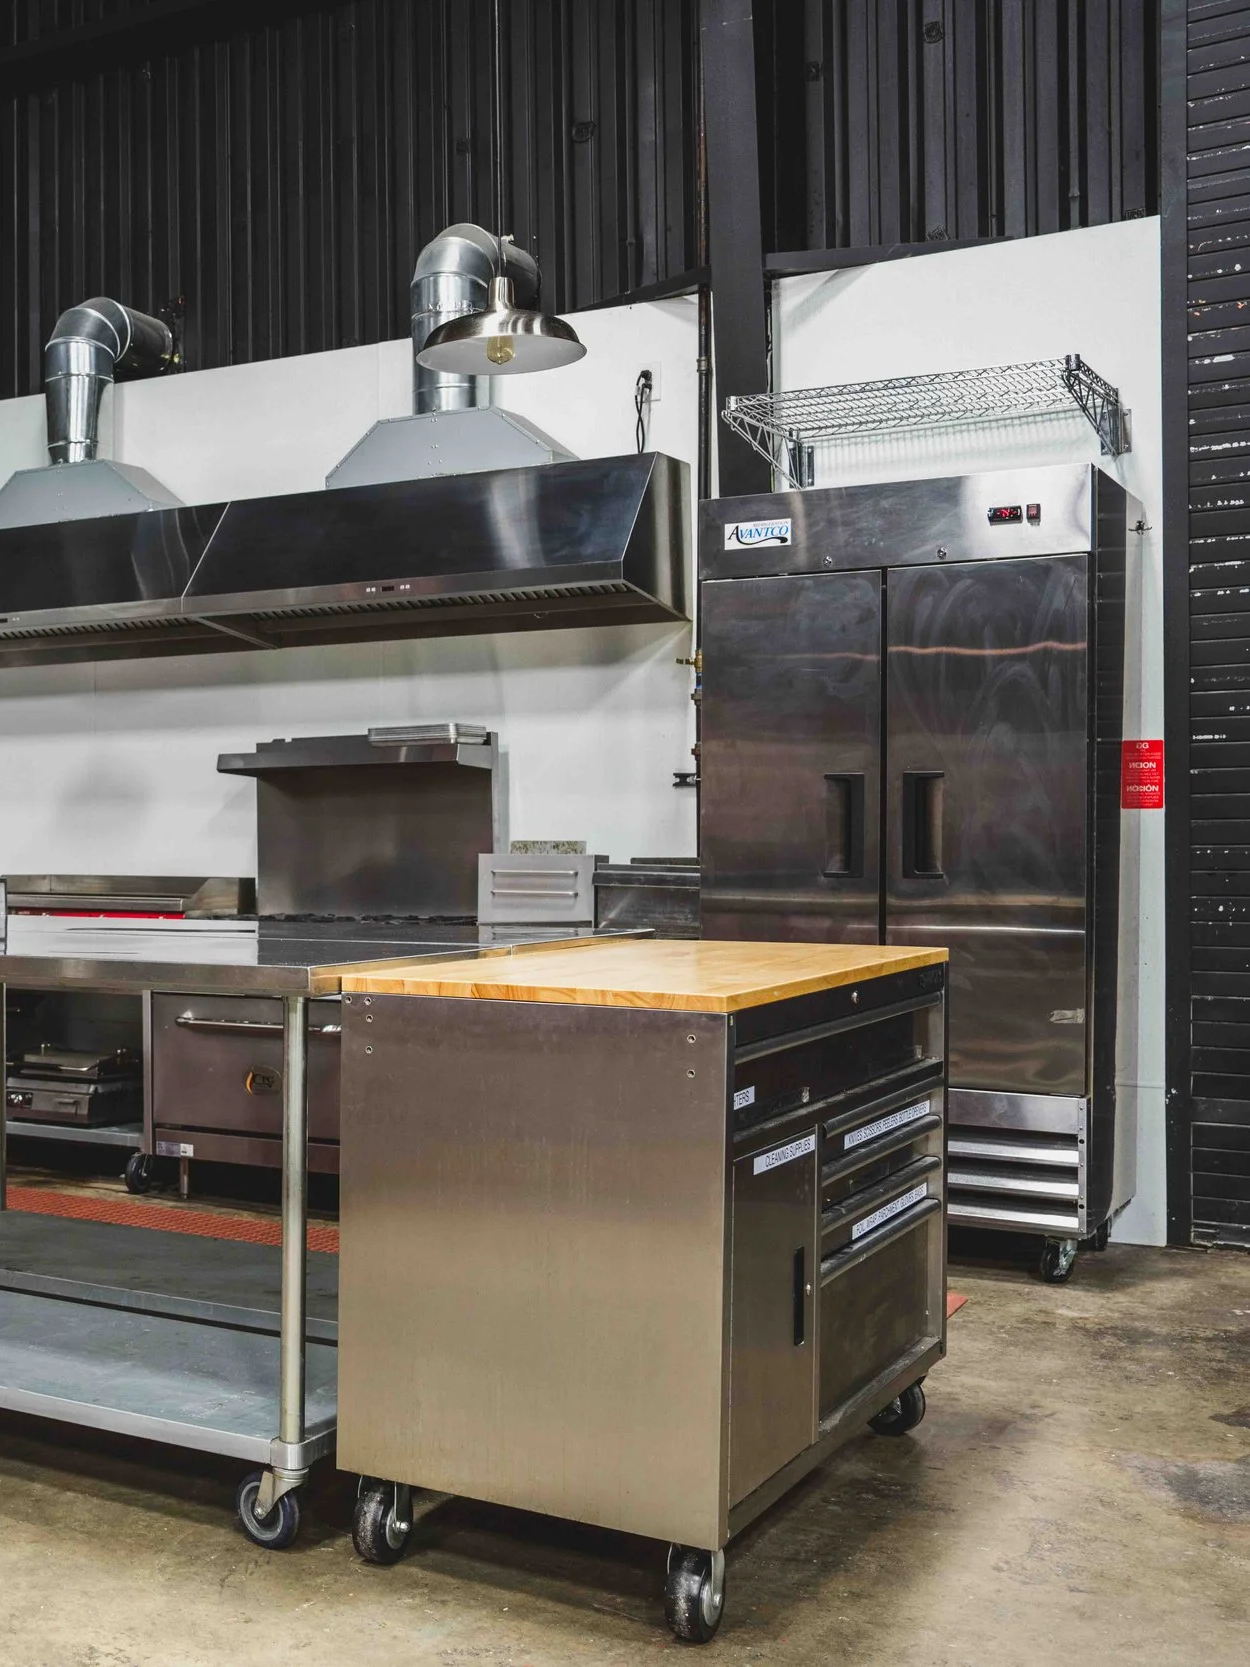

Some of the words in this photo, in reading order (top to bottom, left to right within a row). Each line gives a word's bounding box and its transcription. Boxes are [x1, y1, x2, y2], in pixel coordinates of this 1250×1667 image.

[727, 525, 789, 545] AVANTCO
[765, 1147, 789, 1168] CLEANING
[790, 1138, 811, 1157] SUPPLIES
